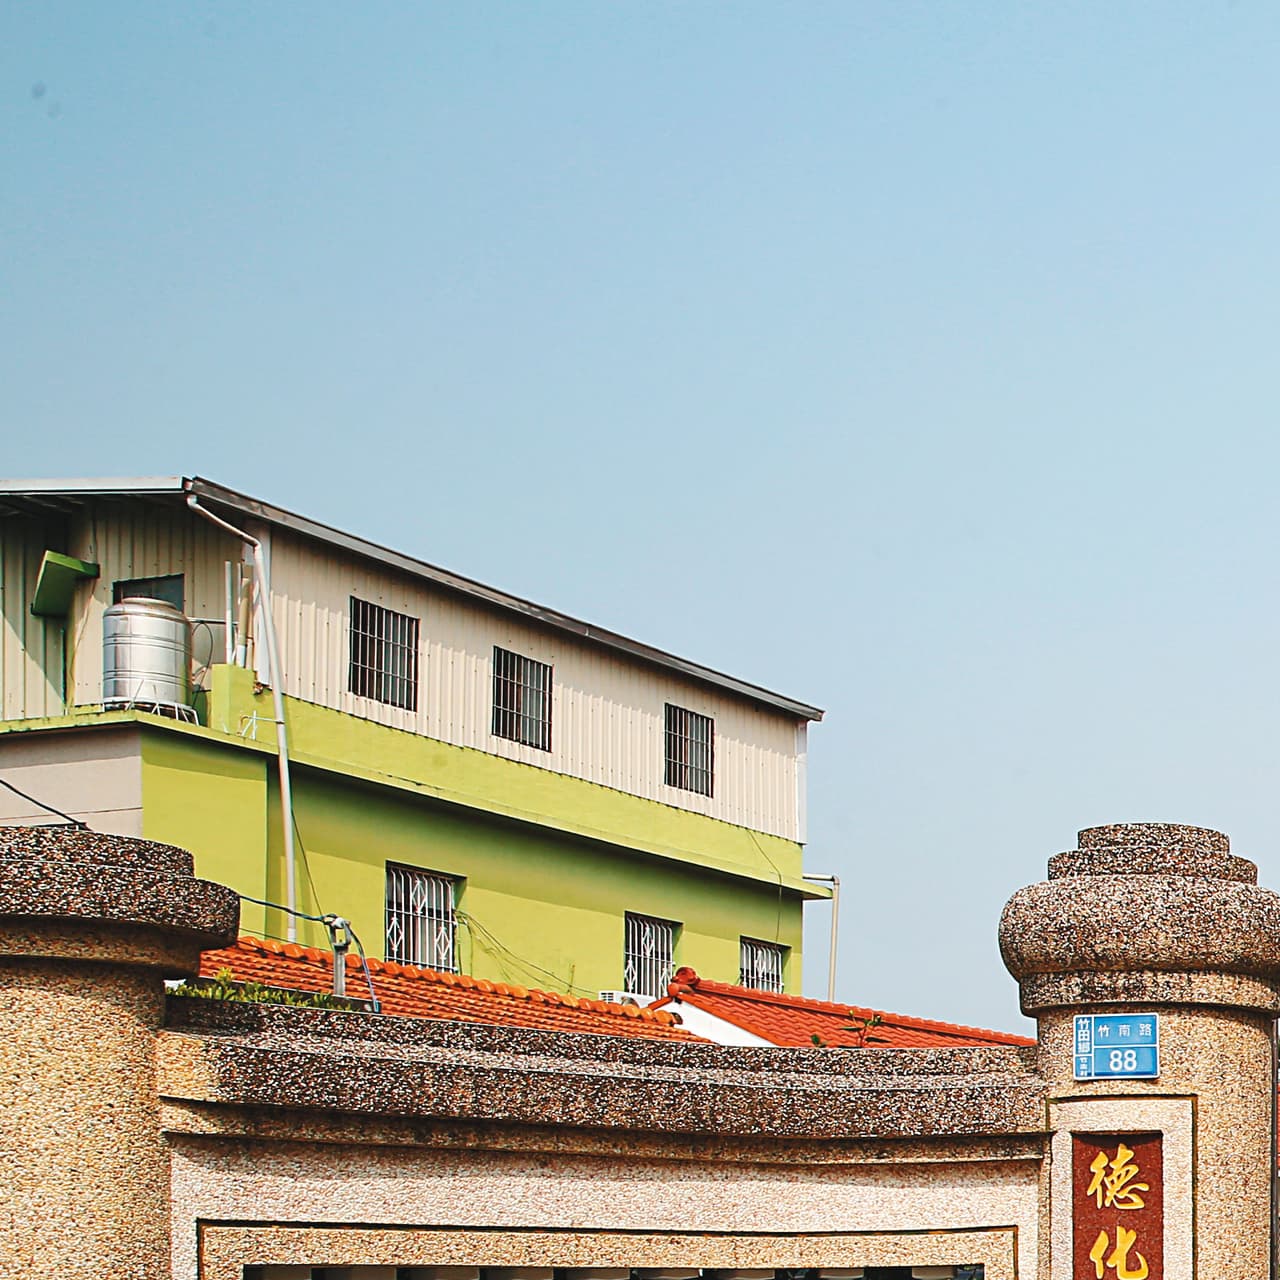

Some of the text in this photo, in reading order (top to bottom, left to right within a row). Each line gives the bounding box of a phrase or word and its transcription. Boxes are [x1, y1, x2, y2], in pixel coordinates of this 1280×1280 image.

[1097, 1023, 1152, 1039] 竹南路
[1109, 1049, 1138, 1072] 88
